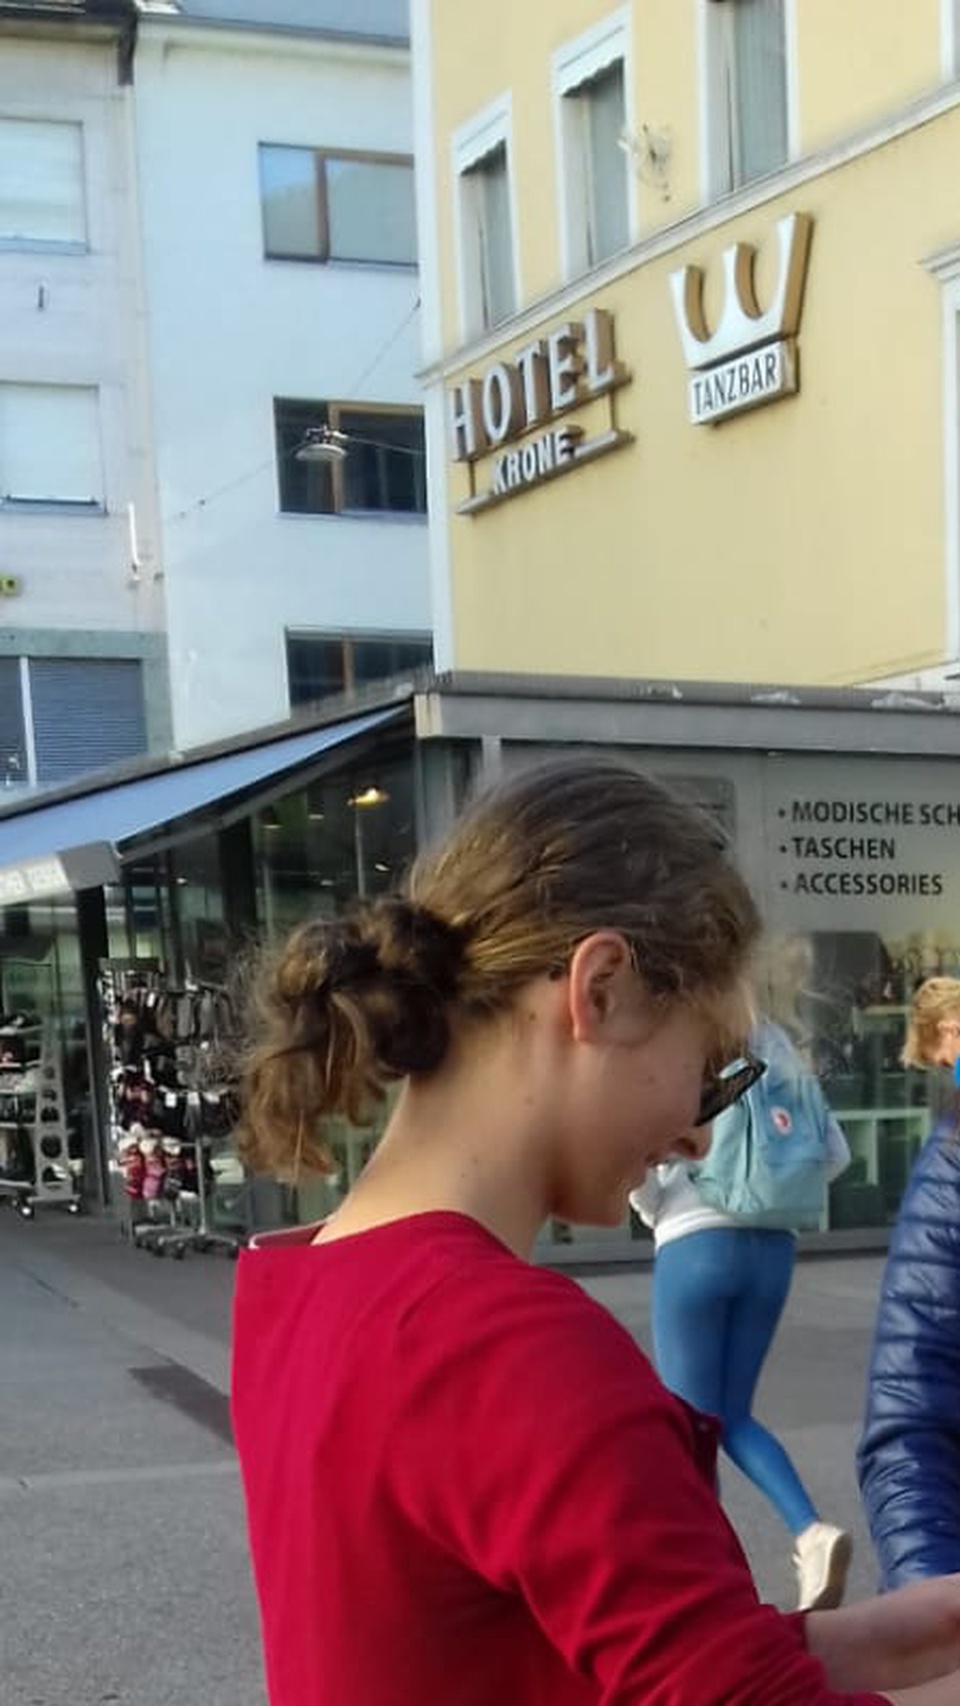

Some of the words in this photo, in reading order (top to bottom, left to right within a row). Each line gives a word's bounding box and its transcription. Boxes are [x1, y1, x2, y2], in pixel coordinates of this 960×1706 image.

[451, 307, 617, 462] HOTEL
[694, 352, 777, 415] TANZBAR
[491, 425, 576, 495] KRONE
[792, 801, 912, 824] MODISCHE
[792, 836, 895, 859] TASCHEN
[795, 873, 942, 895] ACCESSORIES
